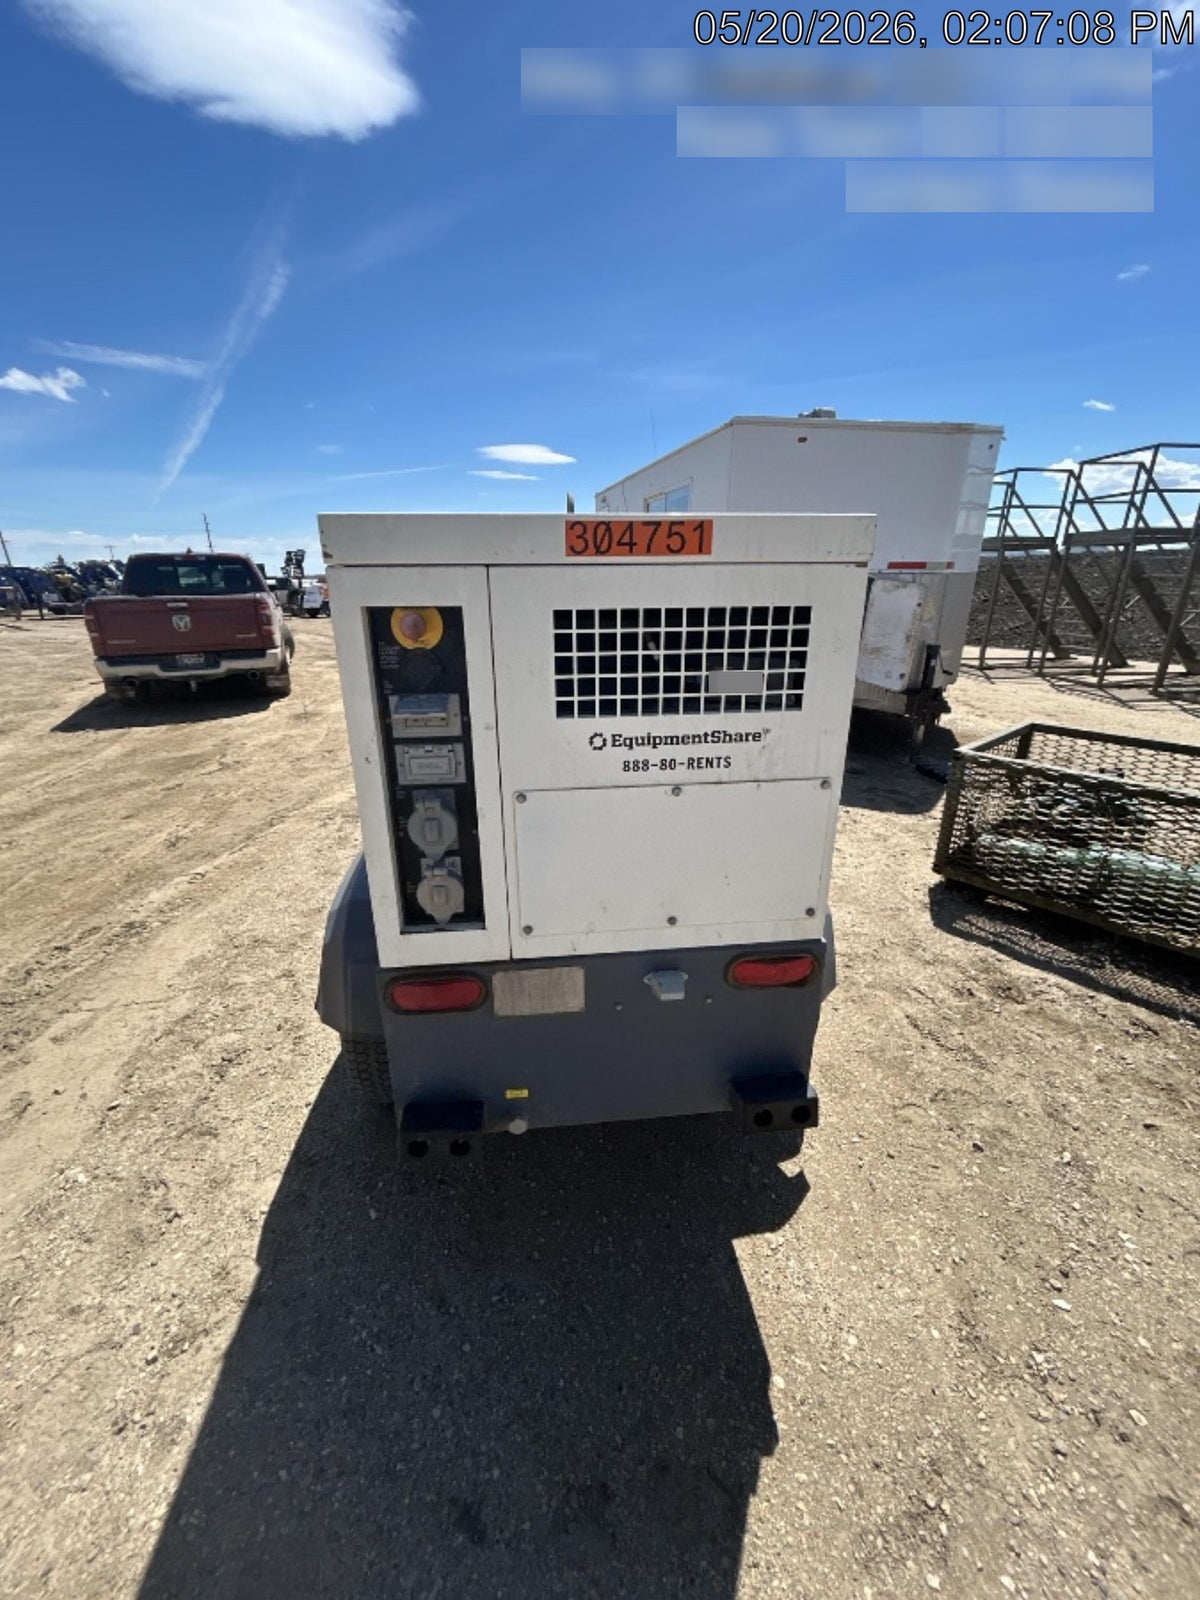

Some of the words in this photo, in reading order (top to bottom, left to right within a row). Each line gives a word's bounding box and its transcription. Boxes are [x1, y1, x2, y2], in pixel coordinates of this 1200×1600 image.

[568, 520, 706, 556] 304751
[610, 729, 762, 750] EquipmentShare
[622, 756, 732, 772] 888-80-RENTS
